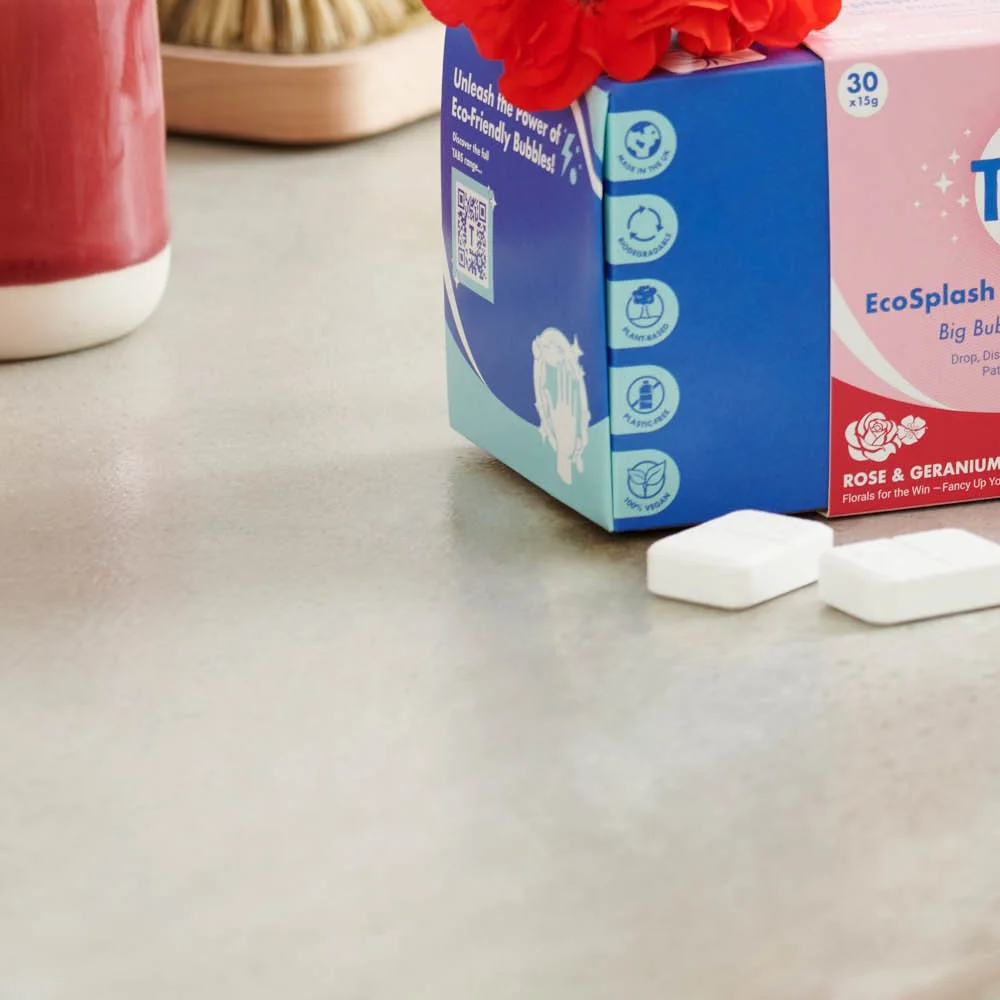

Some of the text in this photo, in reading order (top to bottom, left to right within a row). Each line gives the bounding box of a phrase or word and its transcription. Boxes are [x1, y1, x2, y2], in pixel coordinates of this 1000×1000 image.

[846, 72, 879, 94] 30
[453, 67, 563, 145] Unleash the Power of
[451, 96, 556, 174] Eco-Friendly Bubbles!
[452, 131, 472, 151] Discover
[451, 147, 464, 163] TABS
[865, 279, 995, 315] EcoSplash
[939, 322, 967, 344] Big
[843, 470, 887, 488] ROSE
[892, 468, 905, 482] &
[842, 491, 876, 503] Florals
[877, 488, 892, 500] for
[894, 486, 910, 498] the
[911, 484, 931, 496] Win
[973, 477, 988, 490] Up
[645, 492, 671, 511] VEGAN
